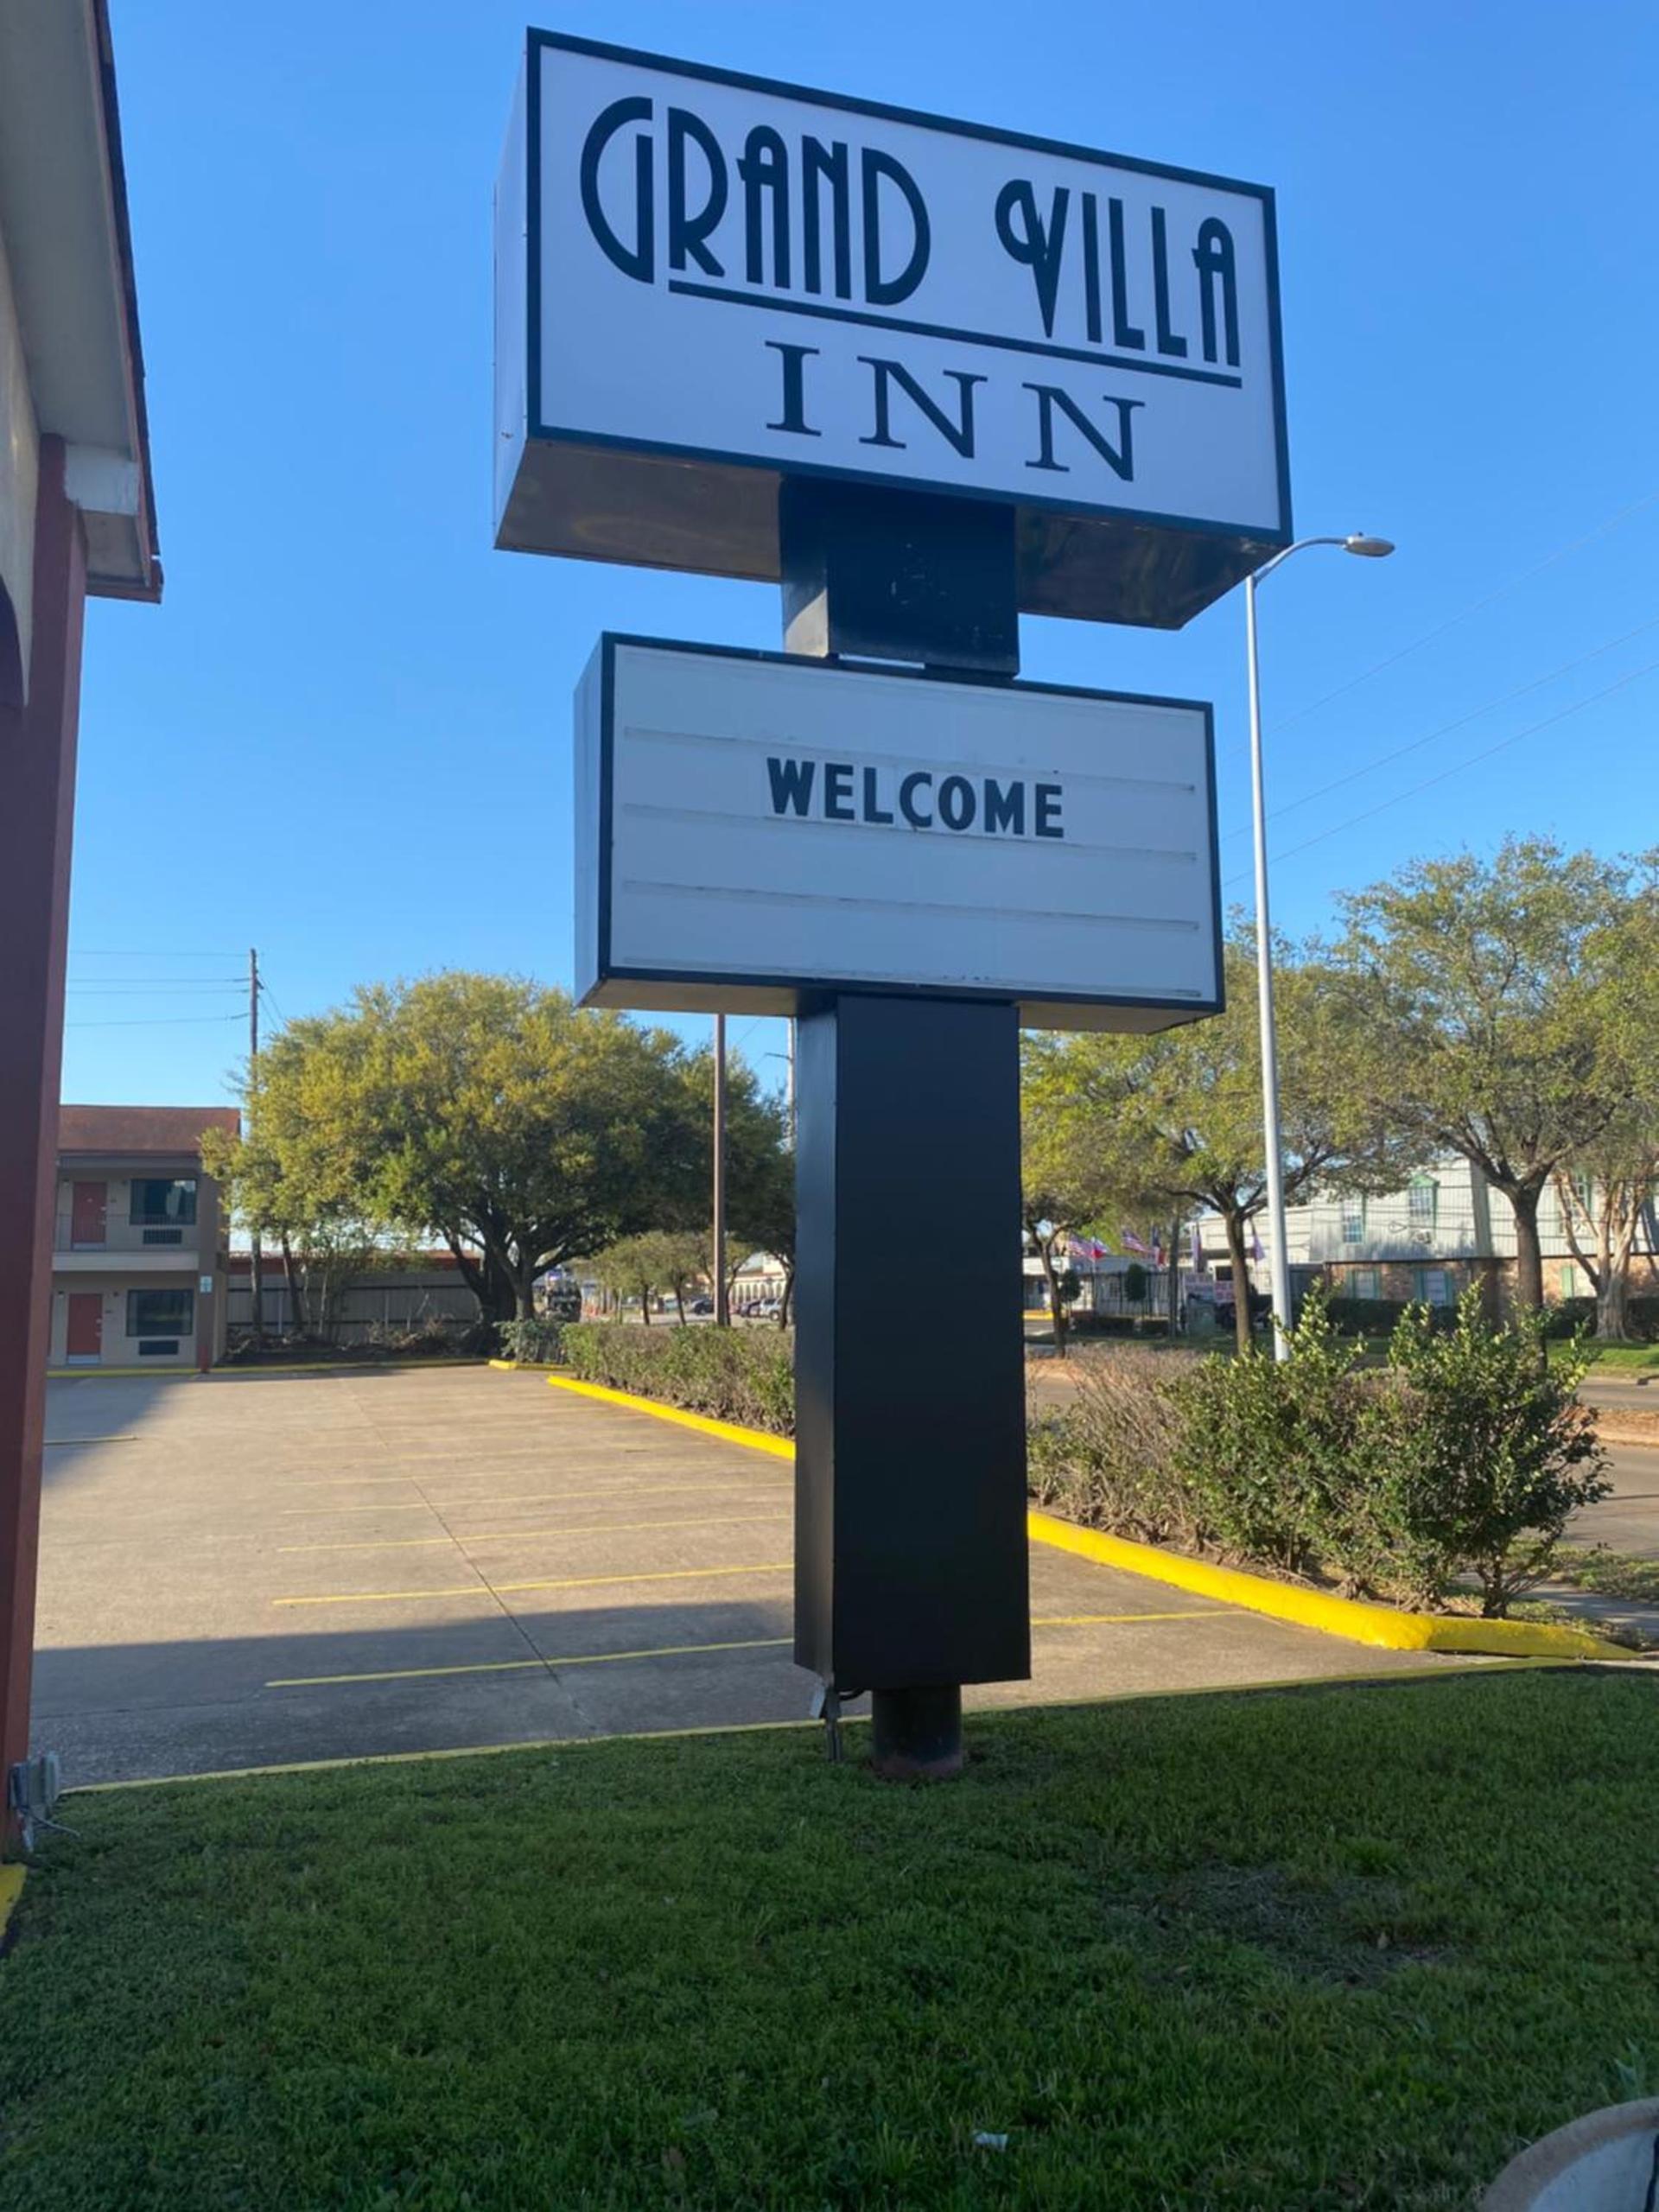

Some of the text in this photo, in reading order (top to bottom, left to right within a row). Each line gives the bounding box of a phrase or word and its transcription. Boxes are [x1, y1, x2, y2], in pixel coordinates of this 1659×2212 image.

[580, 96, 1241, 367] GRAND VILLA
[765, 341, 1146, 482] INN
[766, 757, 1065, 839] WELCOME
